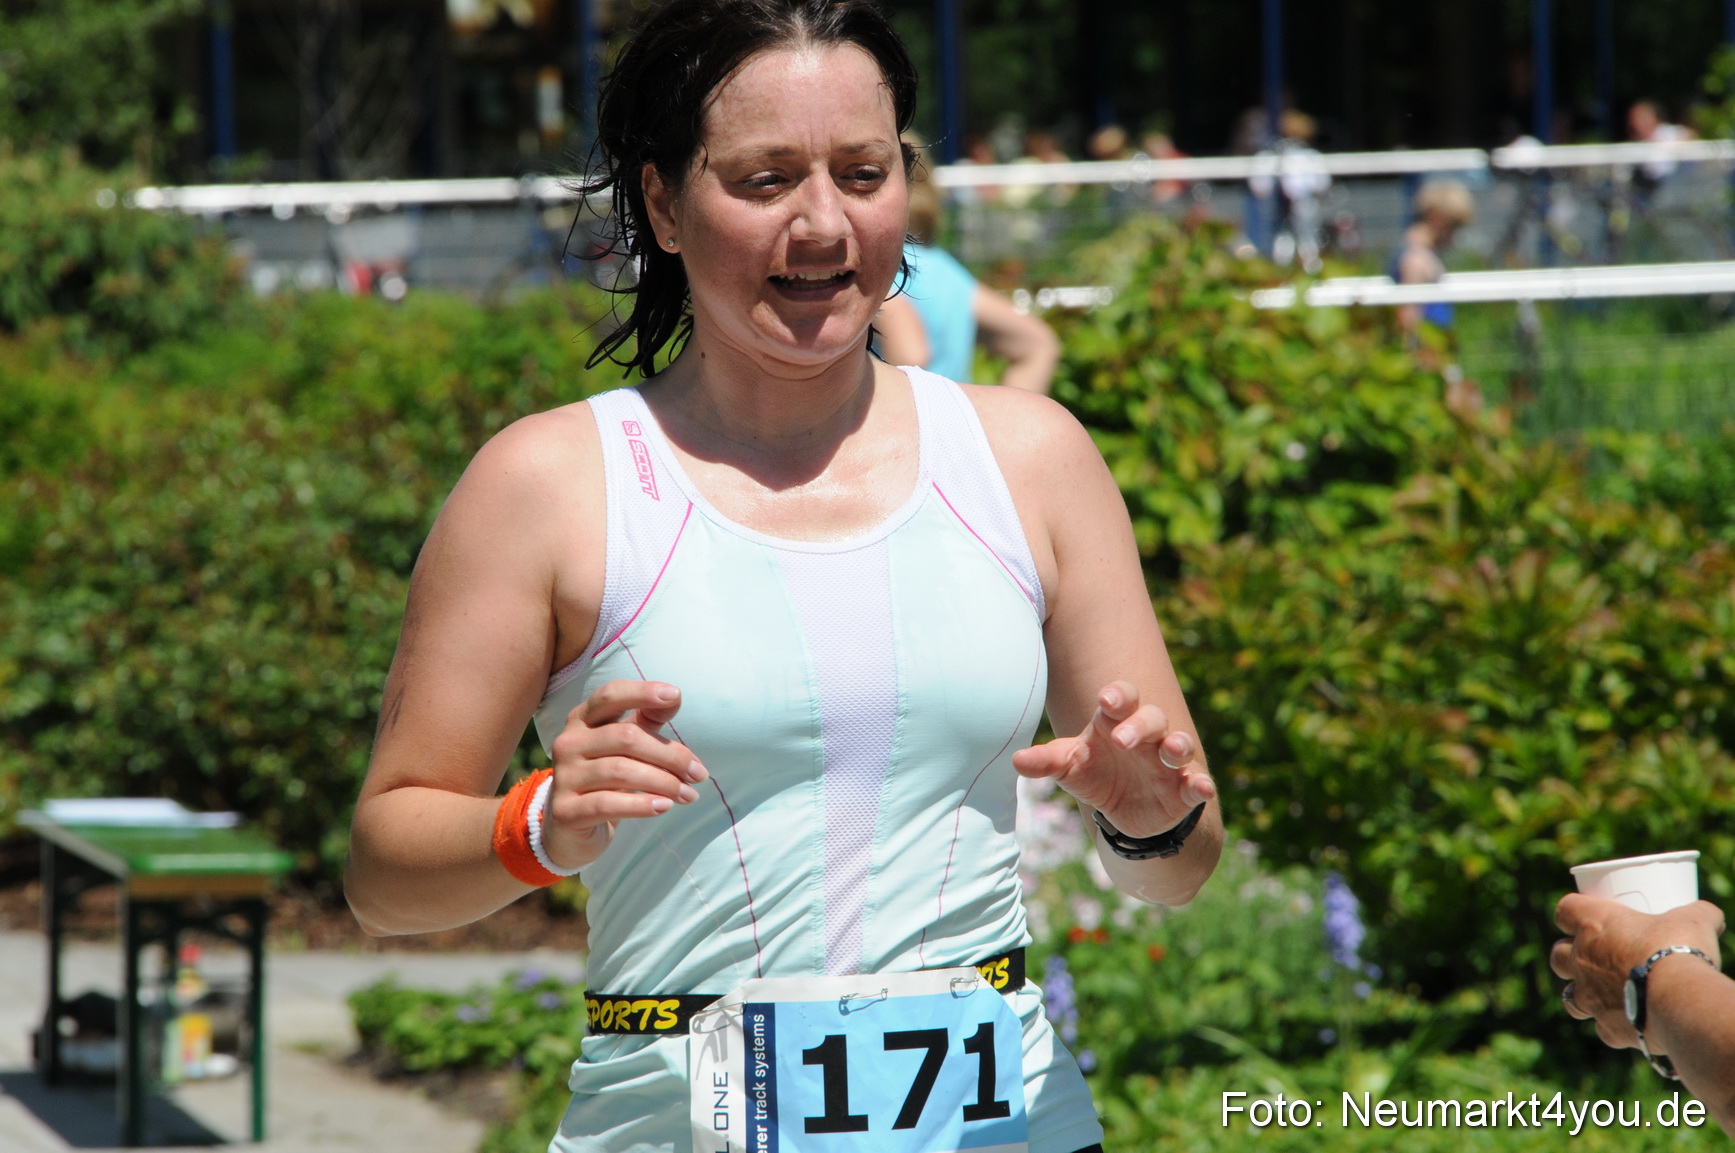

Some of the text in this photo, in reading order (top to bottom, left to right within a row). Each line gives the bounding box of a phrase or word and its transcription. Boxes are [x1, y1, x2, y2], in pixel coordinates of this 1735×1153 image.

[976, 957, 1009, 989] TS
[752, 1014, 769, 1078] systems
[752, 1081, 768, 1120] track
[802, 1021, 1011, 1134] 171
